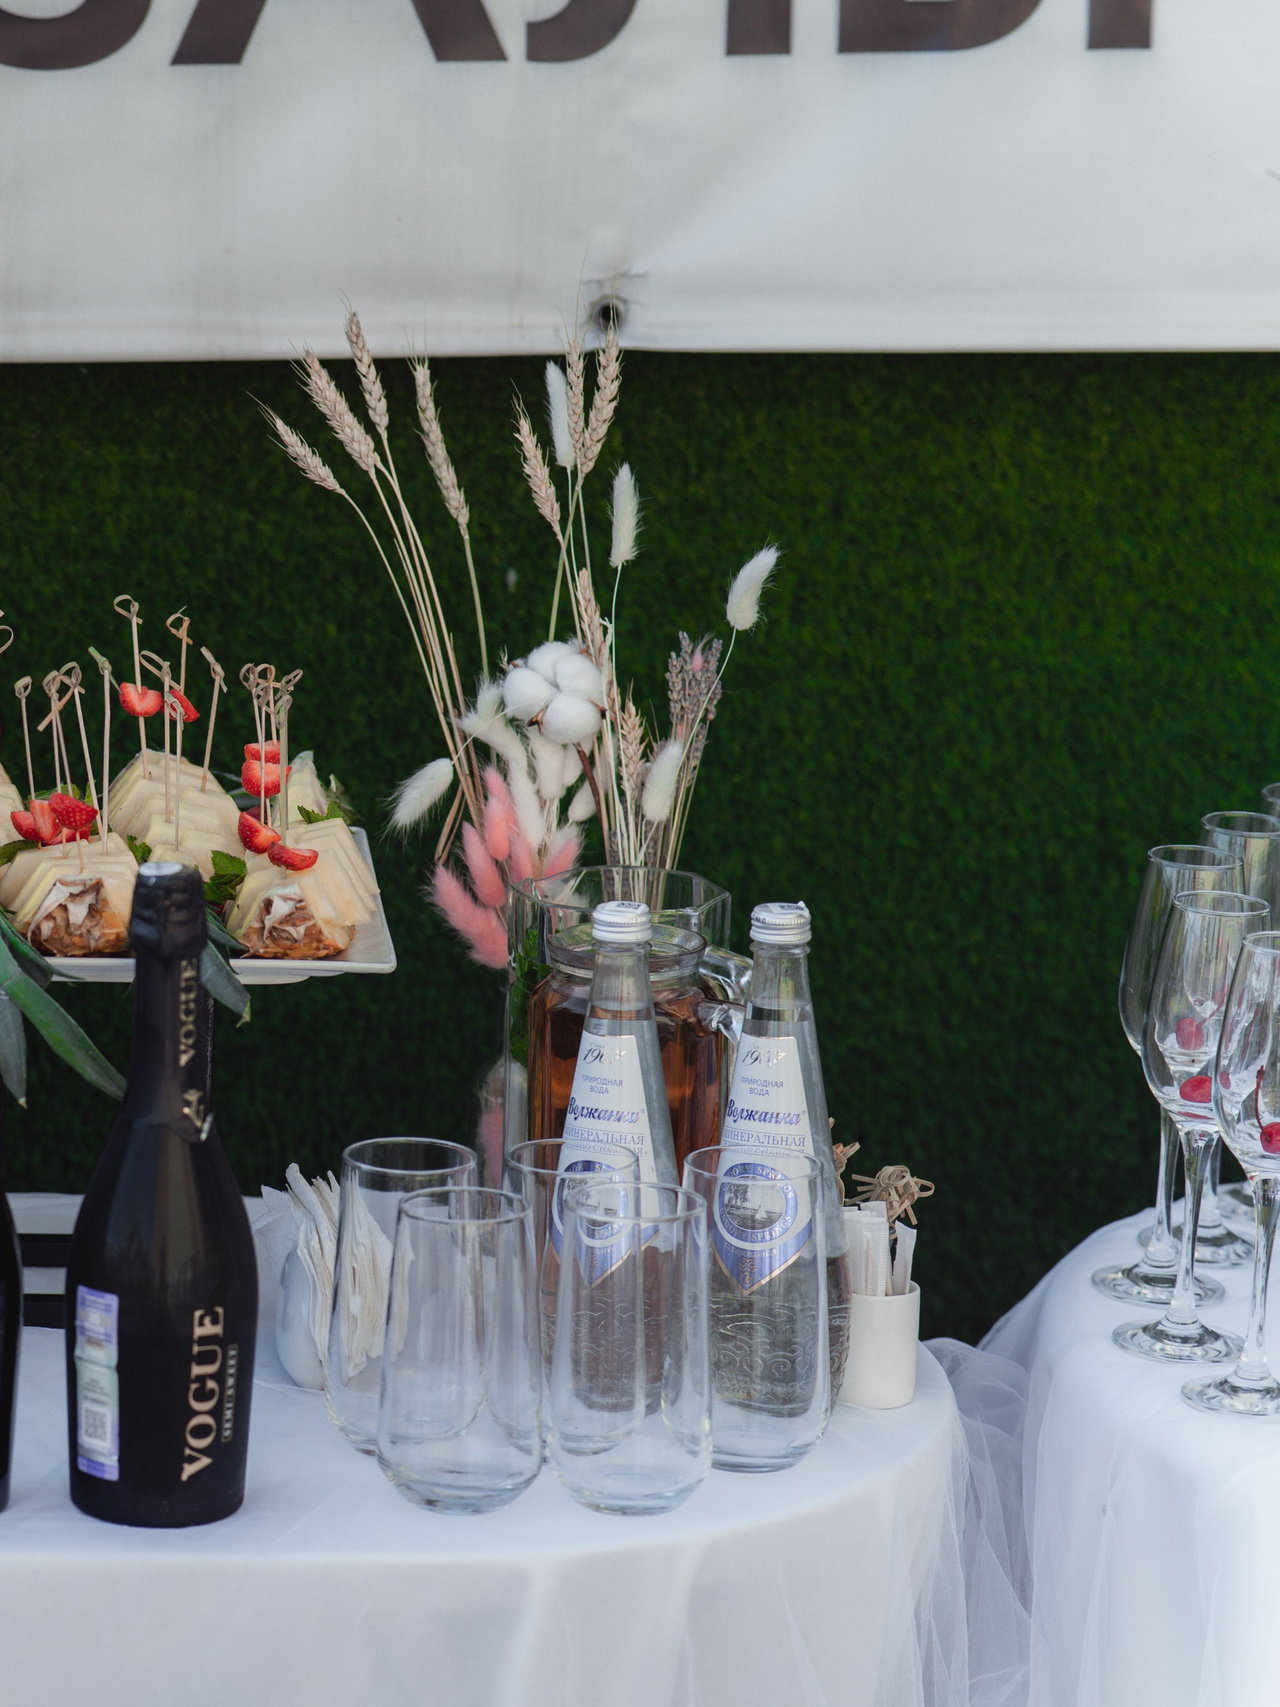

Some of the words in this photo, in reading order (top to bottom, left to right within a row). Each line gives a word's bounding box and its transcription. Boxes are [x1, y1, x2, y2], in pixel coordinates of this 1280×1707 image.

[179, 958, 198, 1067] VOGUE
[582, 1074, 623, 1087] ПРИРОДНАЯ
[741, 1076, 784, 1088] ПРИРОДНАЯ
[589, 1085, 609, 1094] ВОДА
[749, 1087, 770, 1097] ВОДА
[752, 1215, 792, 1241] SPRINGS
[181, 1306, 224, 1481] VOGUE
